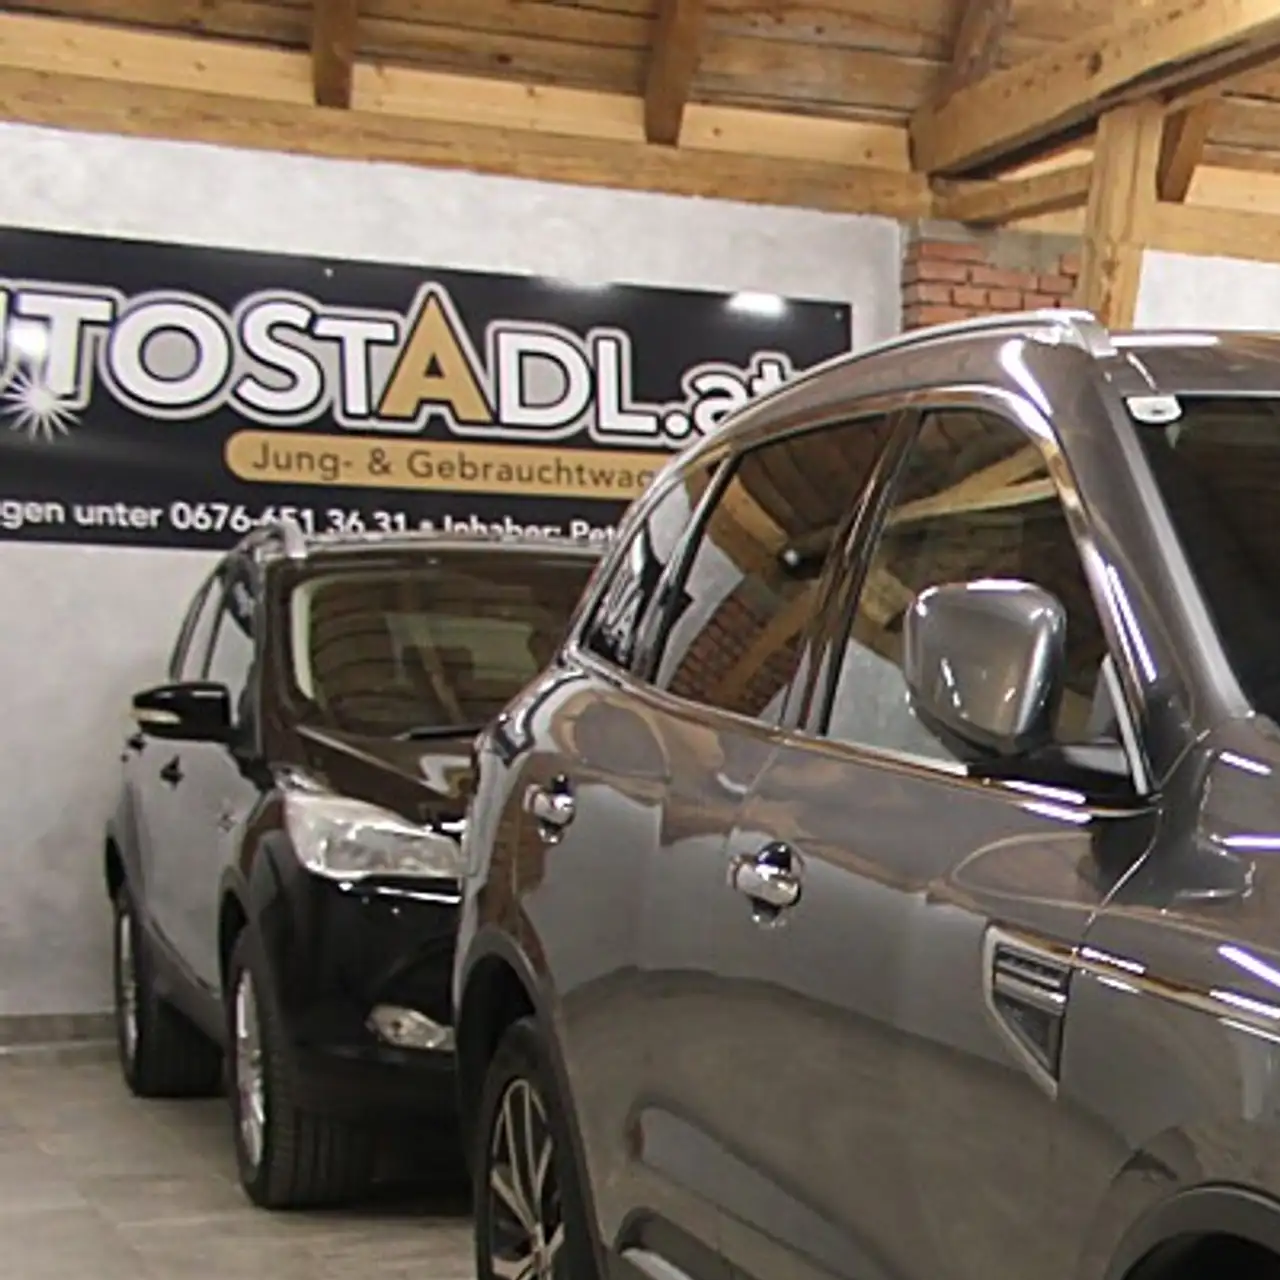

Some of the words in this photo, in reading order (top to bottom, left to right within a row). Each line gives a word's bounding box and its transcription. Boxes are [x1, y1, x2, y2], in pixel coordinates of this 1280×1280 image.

[252, 442, 354, 481] Jung-
[367, 447, 392, 476] &
[73, 501, 163, 531] unter
